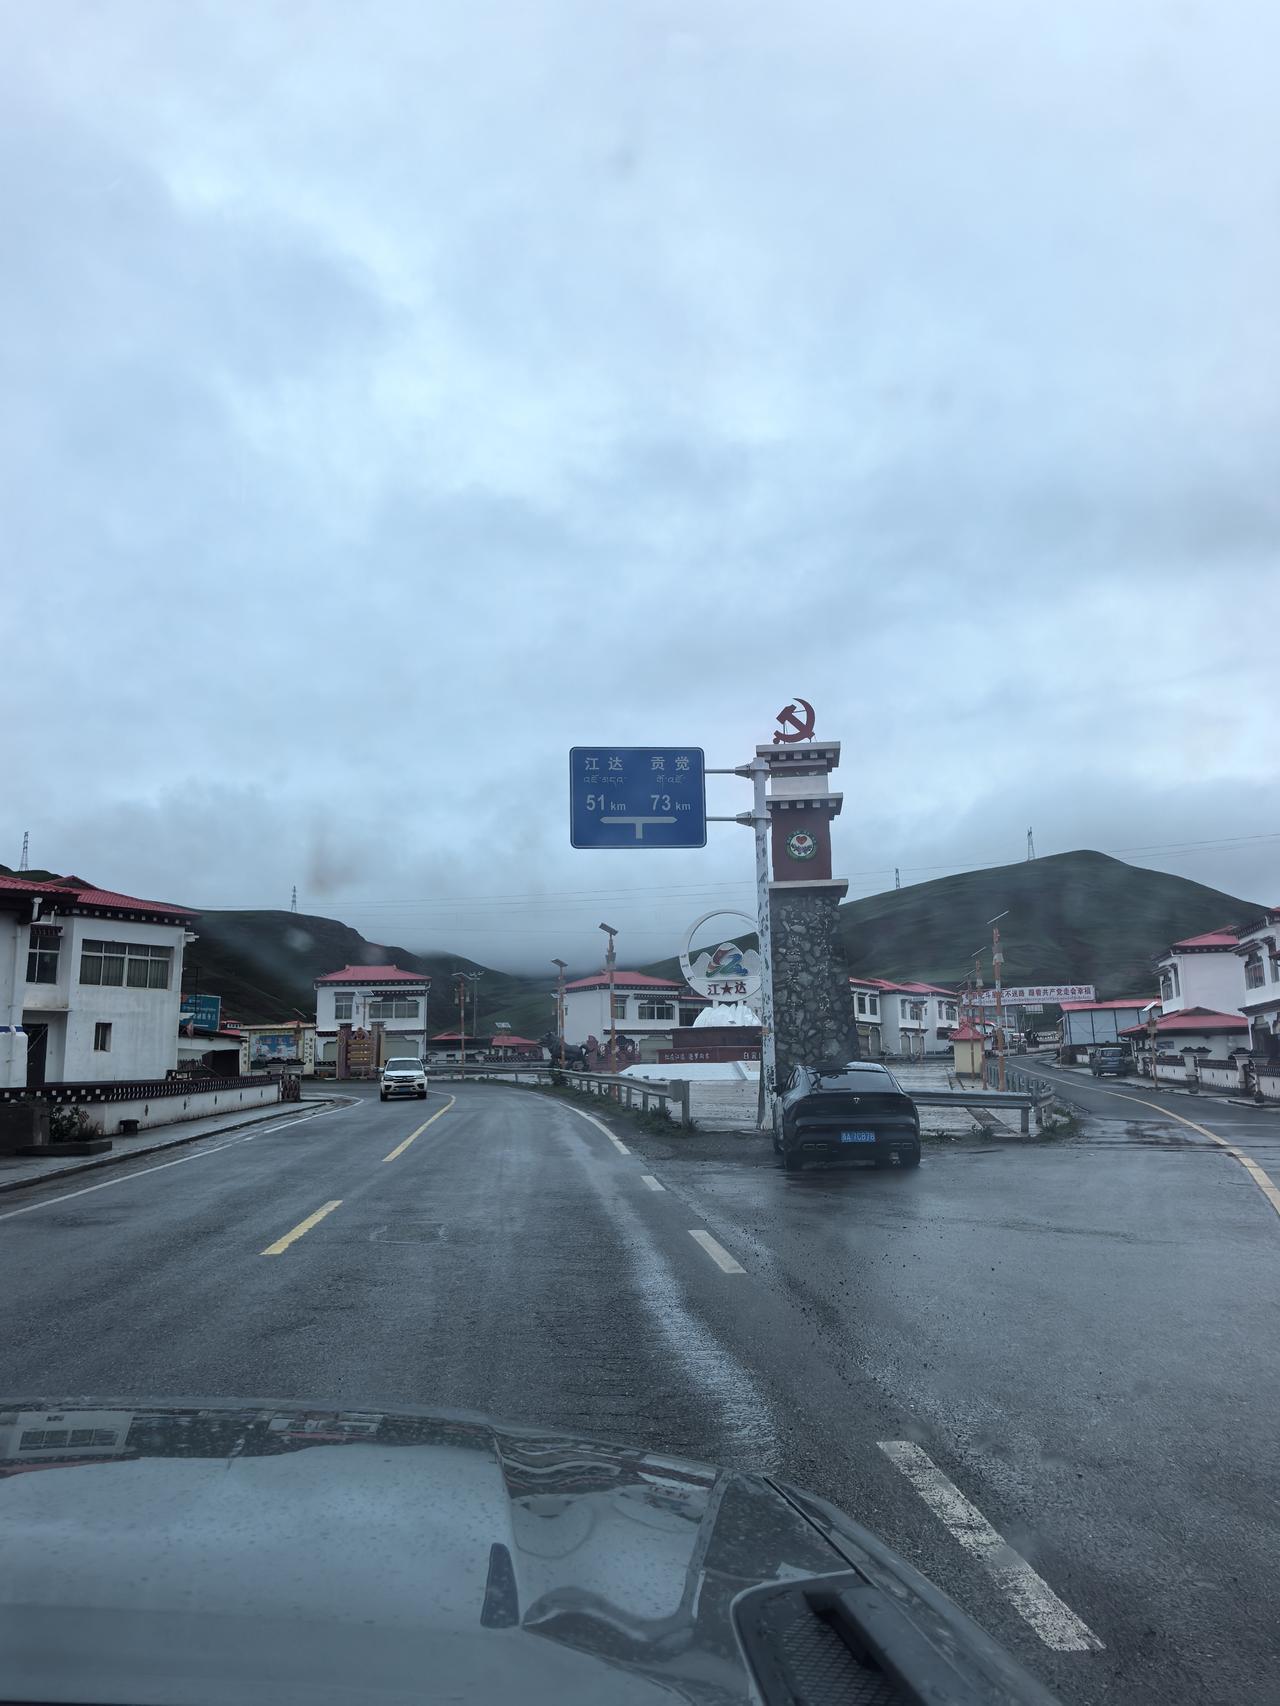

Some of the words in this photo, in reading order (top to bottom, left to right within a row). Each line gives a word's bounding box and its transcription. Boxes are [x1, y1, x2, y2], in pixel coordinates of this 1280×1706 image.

[585, 756, 623, 771] 江达
[651, 756, 690, 771] 贡觉
[586, 794, 605, 811] 51
[610, 802, 626, 811] km
[650, 794, 671, 811] 73
[675, 802, 691, 811] km
